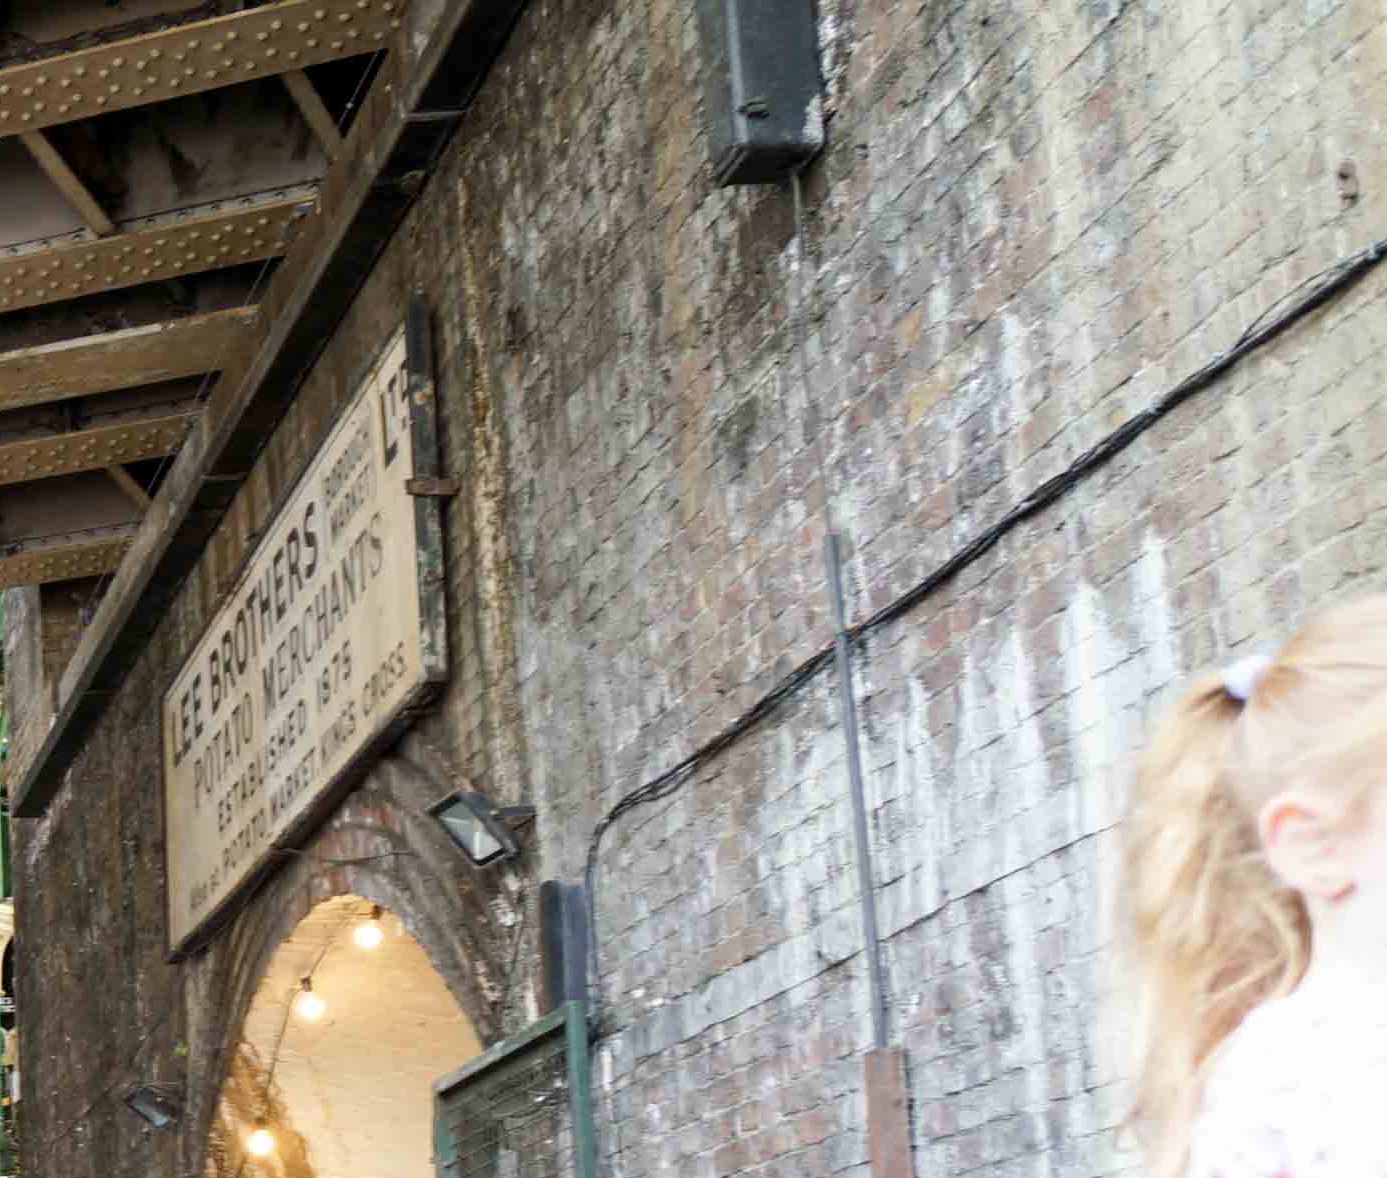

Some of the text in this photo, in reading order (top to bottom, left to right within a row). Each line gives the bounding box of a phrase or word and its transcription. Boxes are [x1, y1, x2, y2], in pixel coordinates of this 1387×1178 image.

[172, 670, 204, 768] LEE
[208, 501, 319, 717] BROTHERS
[193, 511, 384, 810] POTATO MERCHANTS
[218, 699, 308, 834] ESTABLISHED
